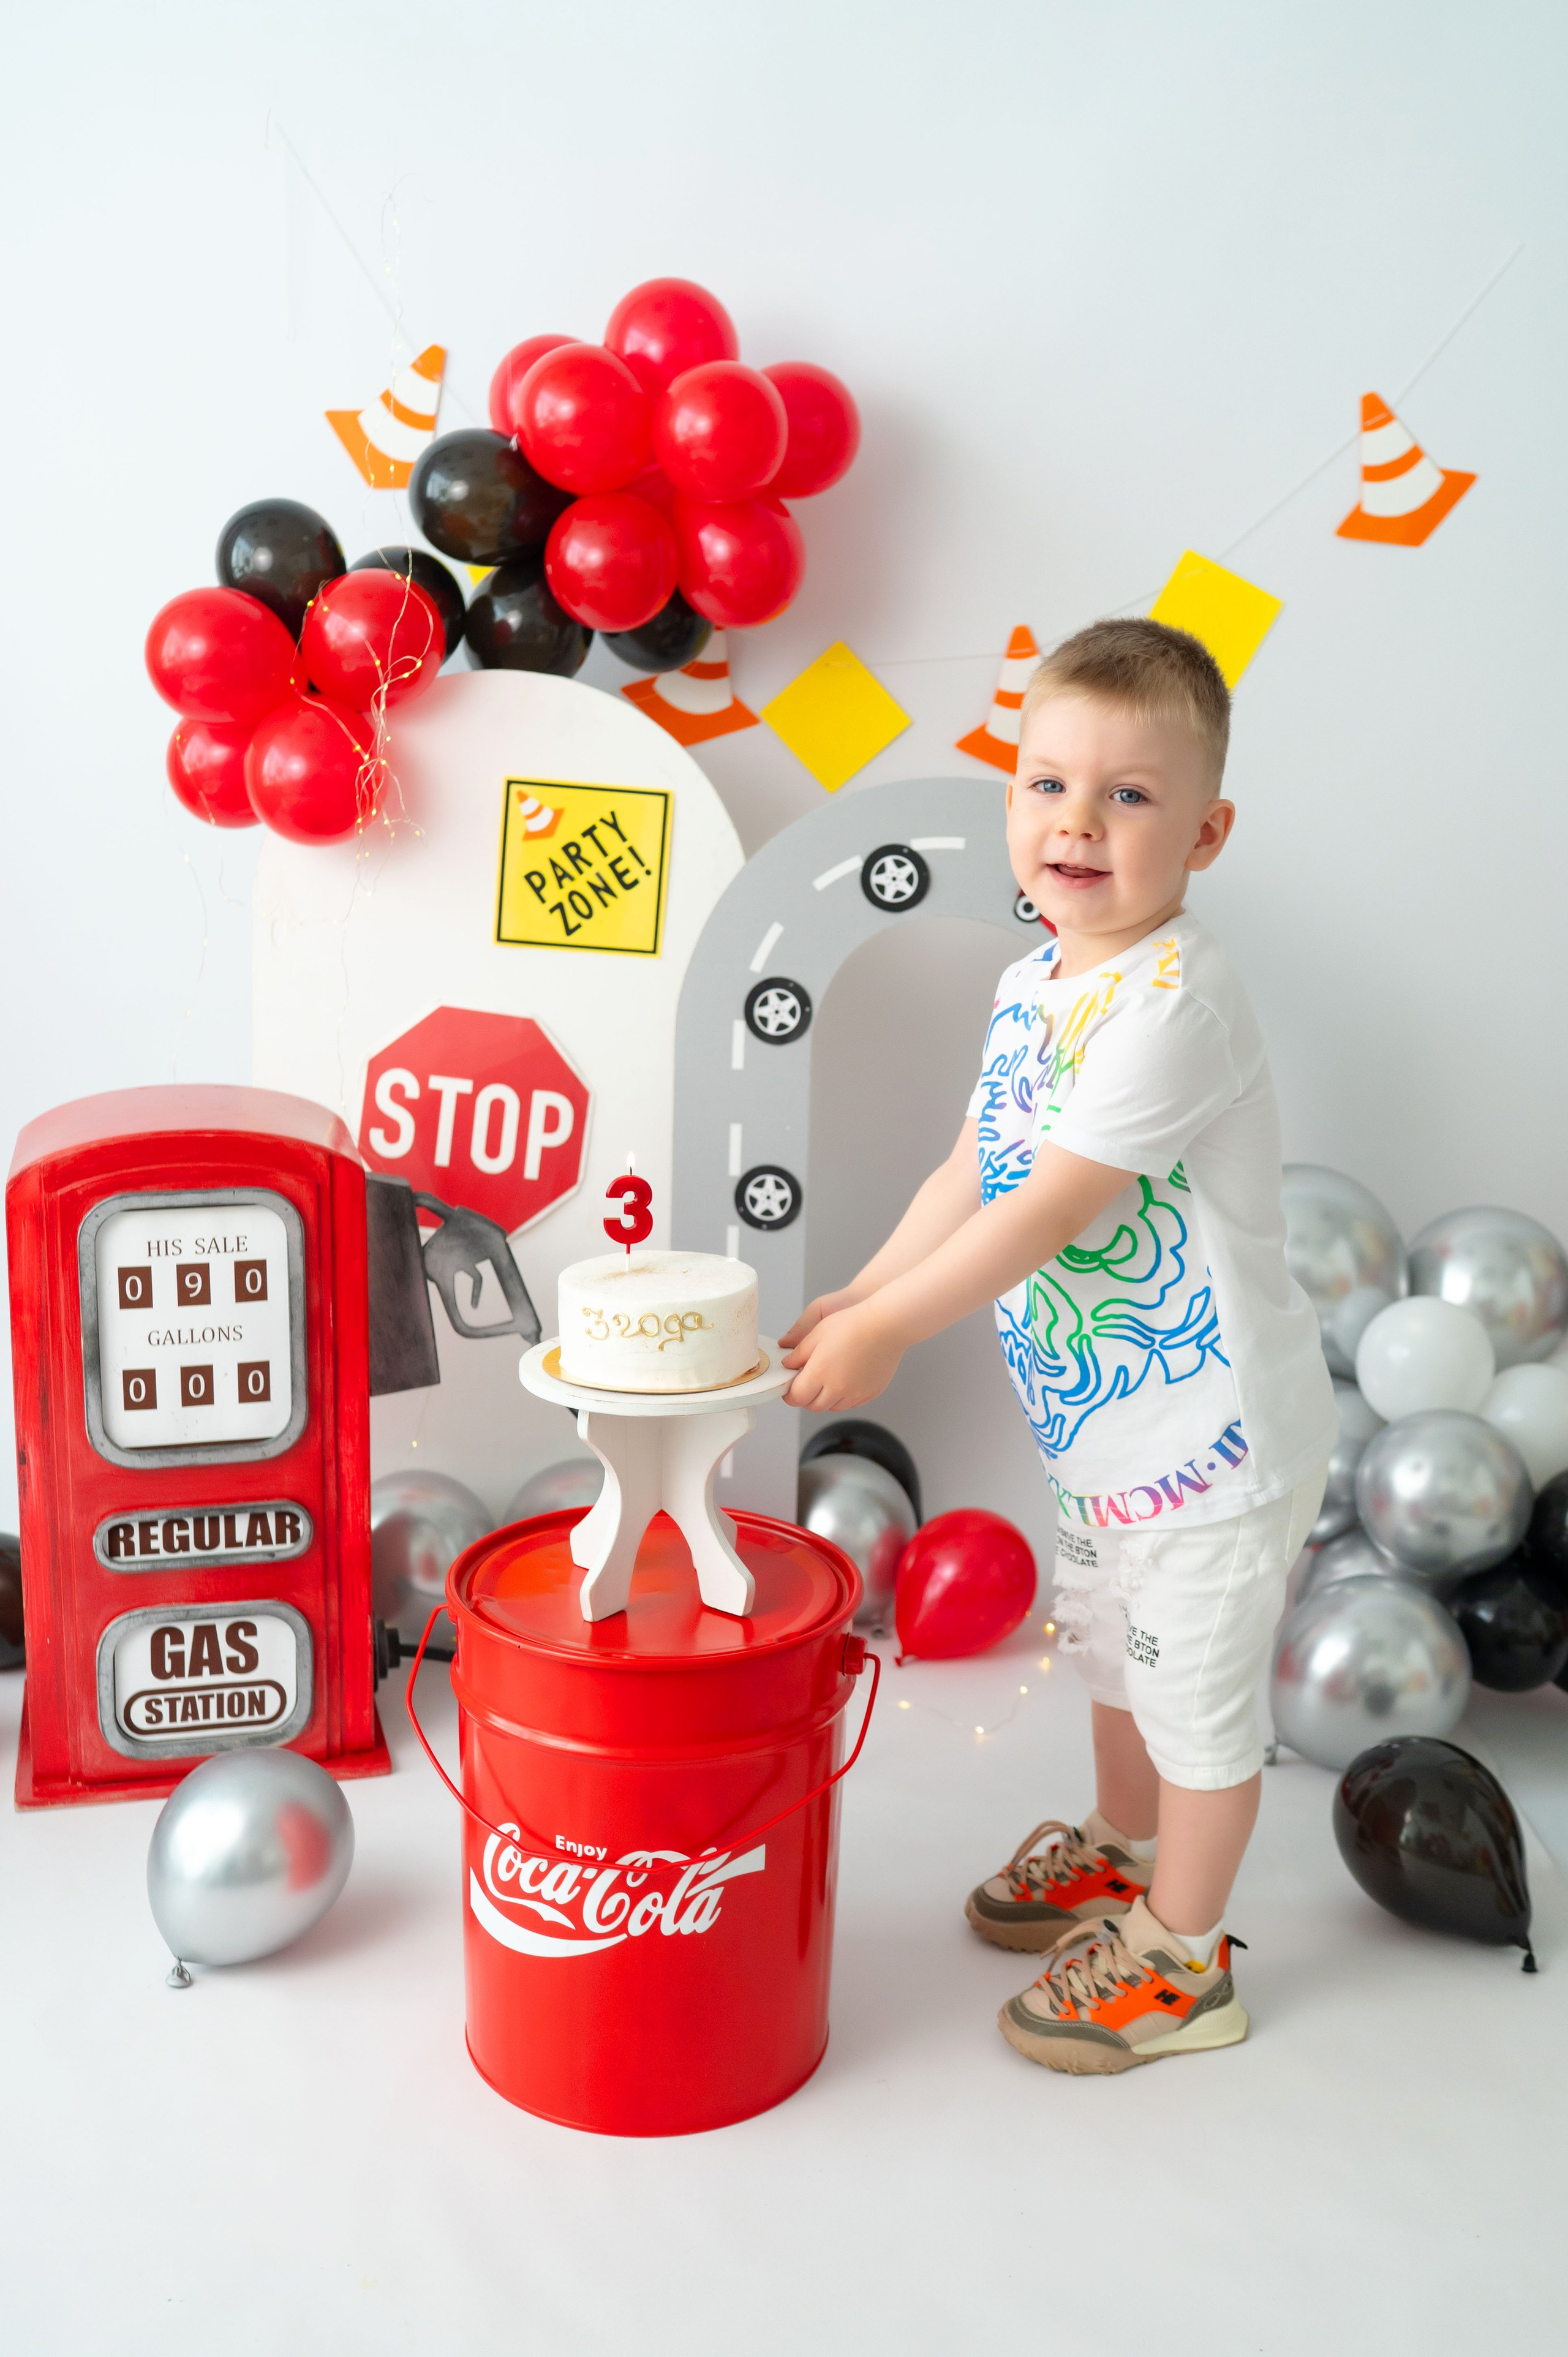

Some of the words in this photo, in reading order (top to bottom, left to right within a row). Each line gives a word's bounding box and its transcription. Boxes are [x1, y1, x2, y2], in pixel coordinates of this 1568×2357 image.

[524, 810, 627, 904] PARTY
[549, 845, 652, 937] ZONE!
[369, 1067, 575, 1180] STOP
[603, 1175, 654, 1245] 3
[147, 1238, 183, 1258] HIS
[194, 1235, 248, 1254] SALE
[124, 1275, 143, 1301] 0
[184, 1272, 203, 1298] 9
[245, 1268, 263, 1294] 0
[148, 1325, 243, 1347] GALLONS
[582, 1306, 609, 1340] 3
[129, 1377, 146, 1403] 0
[188, 1373, 206, 1399] 0
[247, 1369, 265, 1395] 0
[108, 1510, 301, 1558] REGULAR
[150, 1621, 258, 1680] GAS
[1134, 1640, 1159, 1658] BTON
[1140, 1630, 1159, 1646] THE
[145, 1689, 265, 1725] STATION
[556, 1834, 608, 1861] Enjoy
[483, 1822, 733, 1937] Coca-Cola
